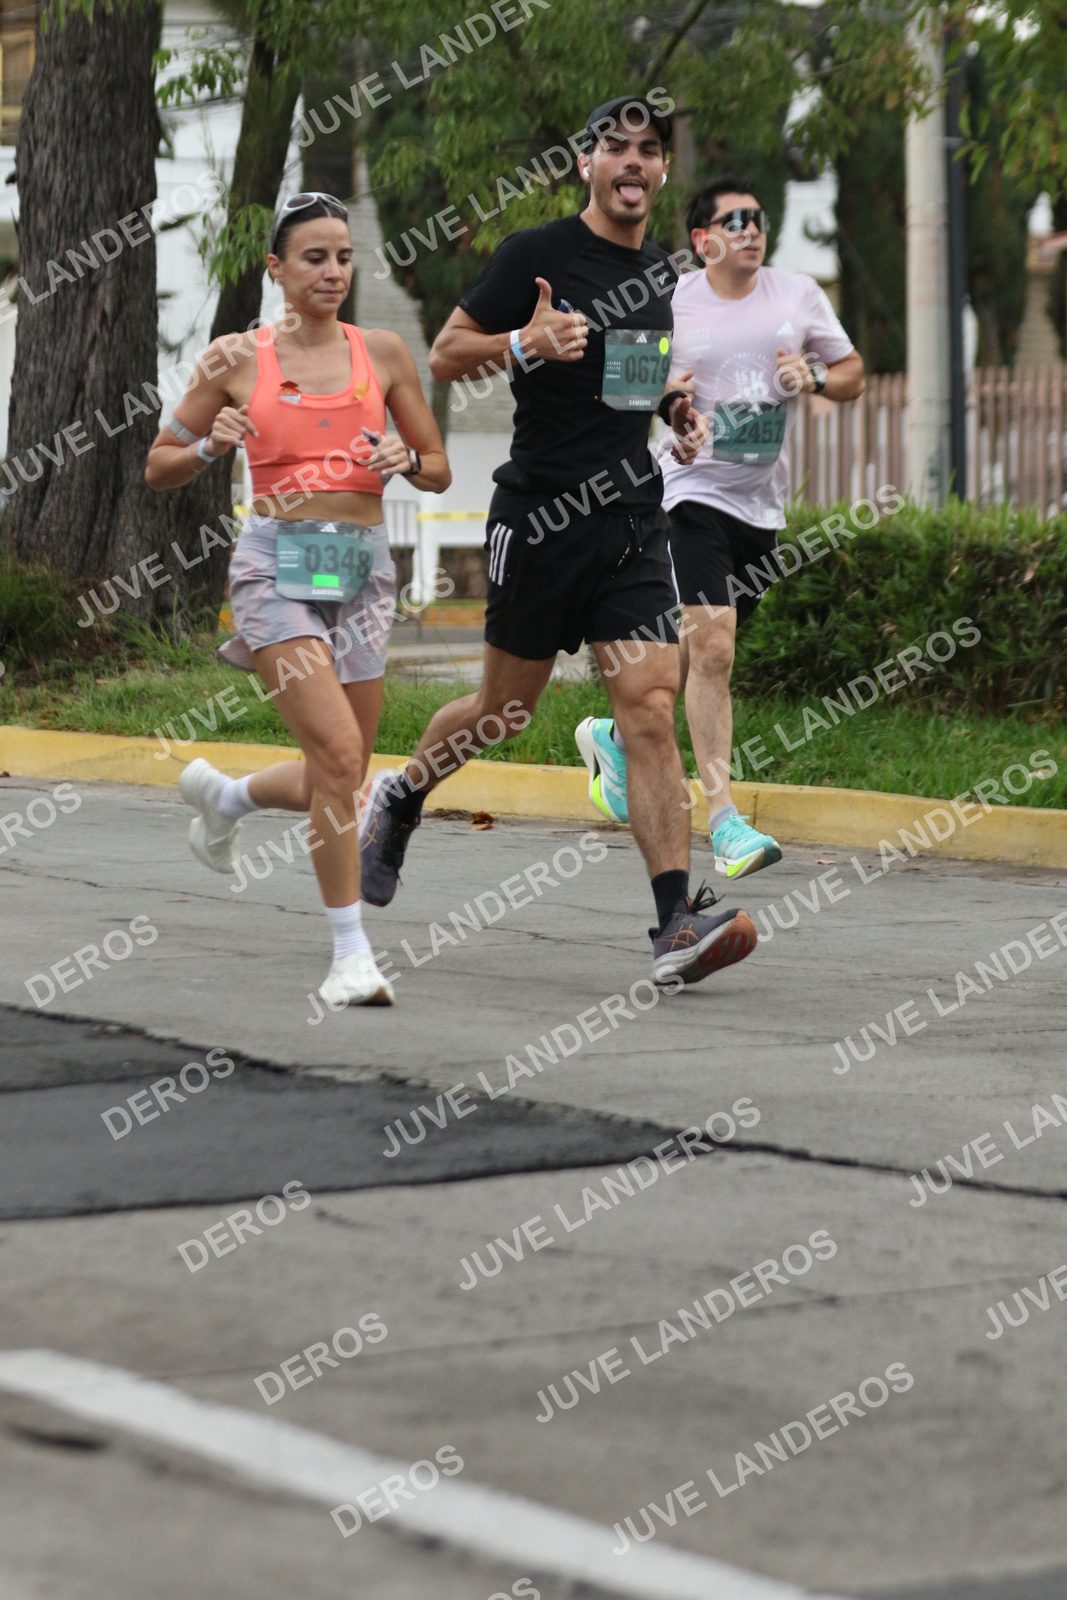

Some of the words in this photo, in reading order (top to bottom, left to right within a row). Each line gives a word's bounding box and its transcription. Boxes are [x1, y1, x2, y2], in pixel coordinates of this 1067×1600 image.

[624, 354, 670, 385] 0679
[734, 420, 784, 443] 2457
[304, 544, 370, 579] 0348
